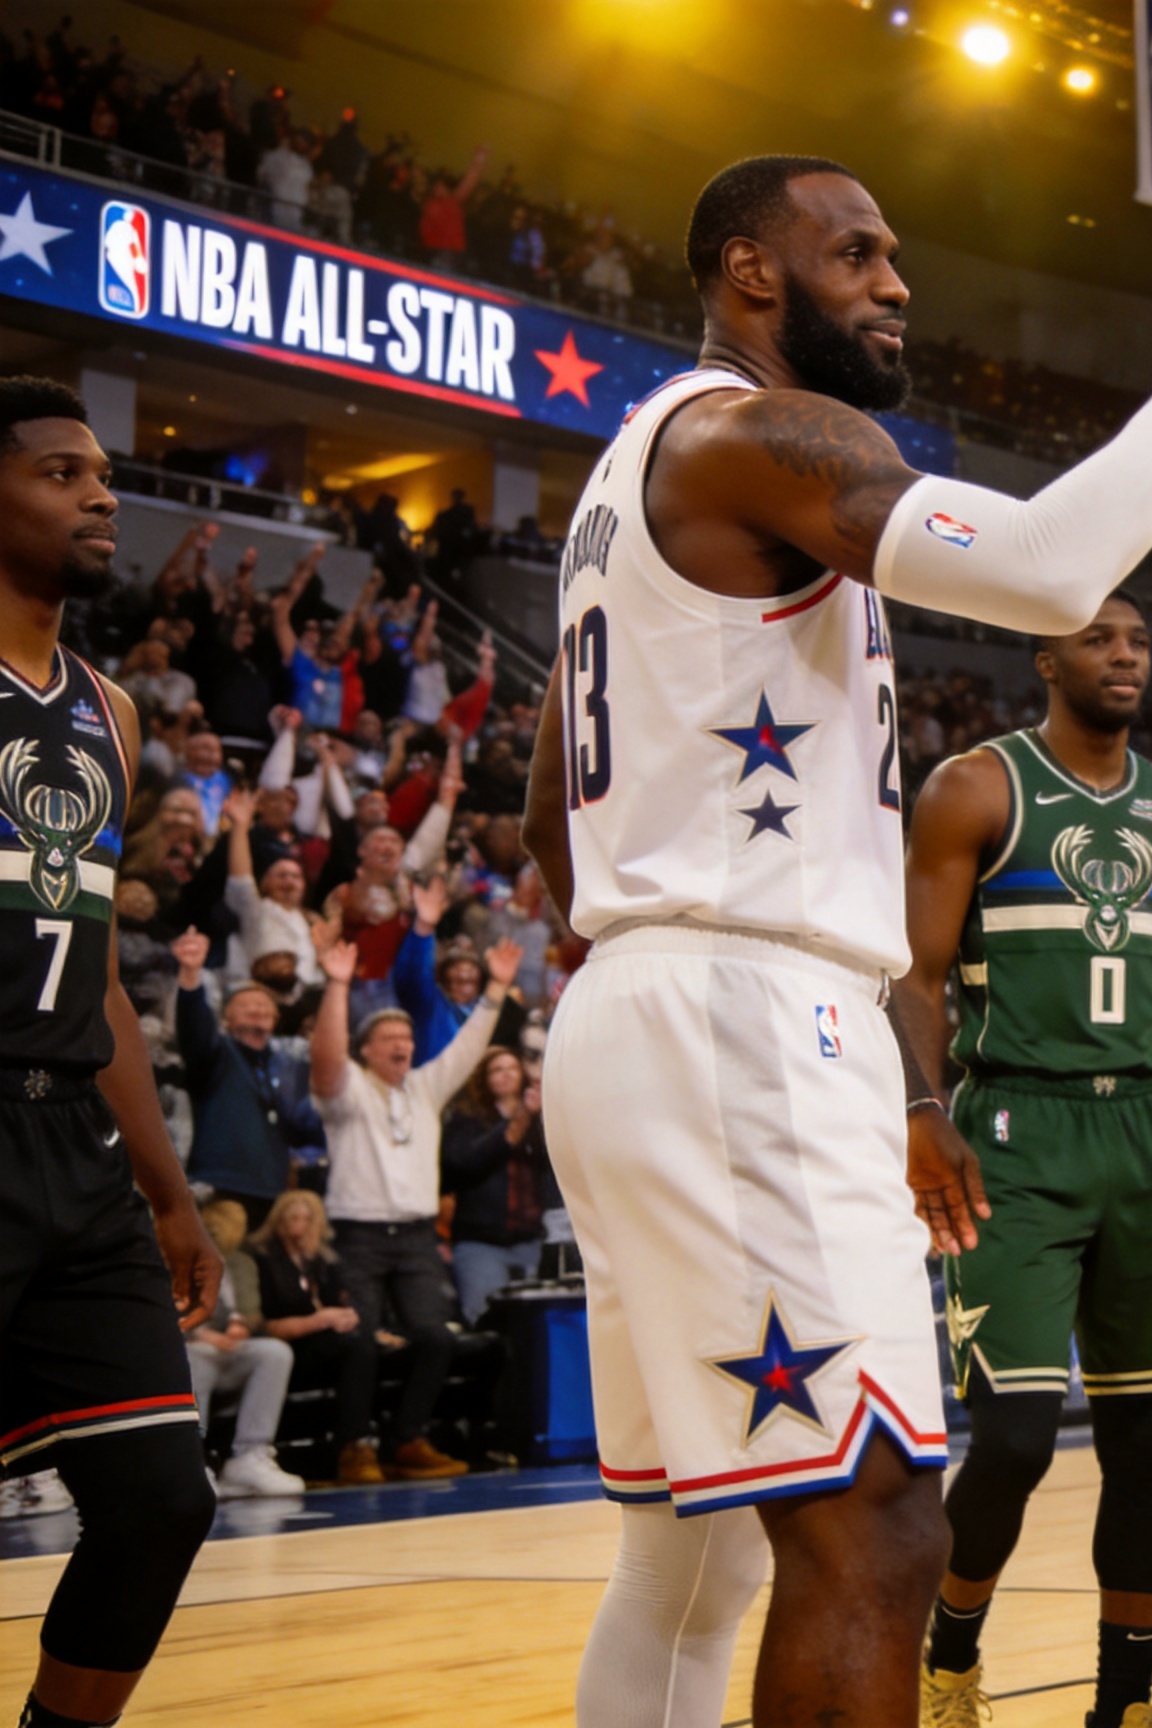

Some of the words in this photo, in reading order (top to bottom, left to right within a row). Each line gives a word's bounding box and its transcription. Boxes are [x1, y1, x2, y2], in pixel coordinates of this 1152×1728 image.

[161, 219, 273, 339] NBA
[281, 254, 516, 400] ALL-STAR
[35, 918, 73, 1011] 7
[1090, 956, 1126, 1024] 0
